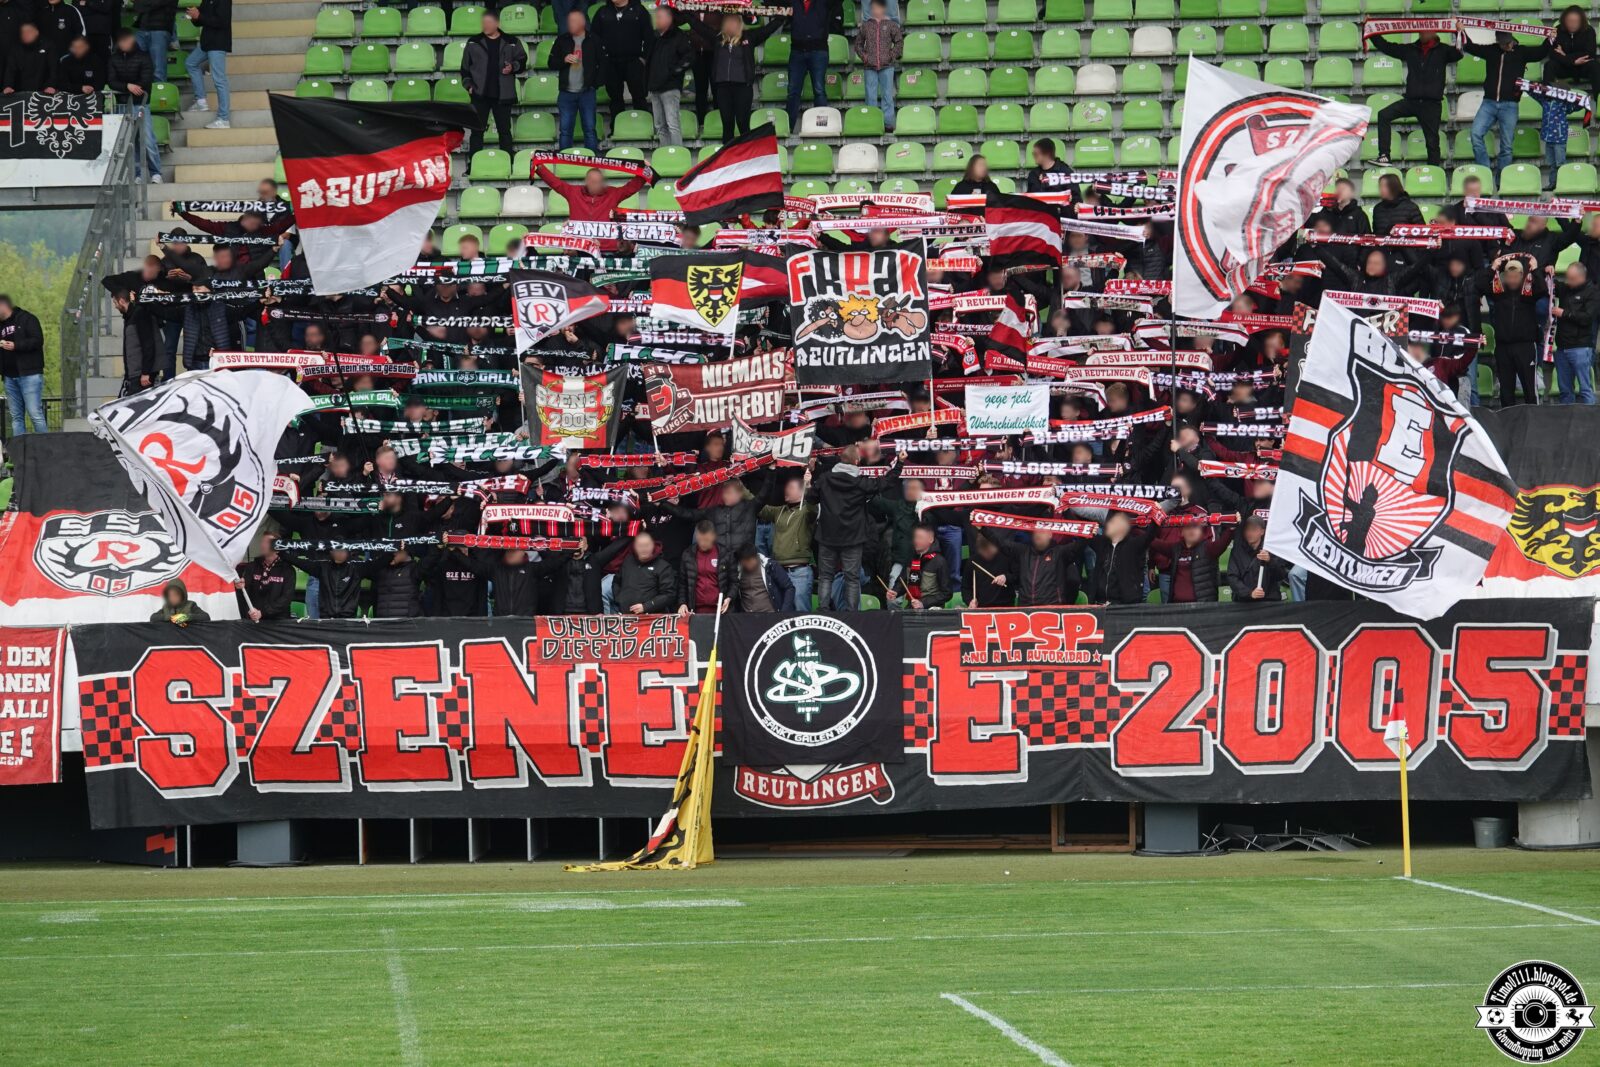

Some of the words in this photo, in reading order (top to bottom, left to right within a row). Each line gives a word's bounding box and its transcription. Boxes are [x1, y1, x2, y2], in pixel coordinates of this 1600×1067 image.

[1376, 22, 1390, 31] SSV
[1392, 21, 1439, 31] REUTLINGEN
[1495, 22, 1545, 35] REUTLINGEN
[535, 152, 554, 161] SSV
[557, 153, 623, 169] REUTLINGEN
[625, 161, 638, 170] 05
[1047, 172, 1107, 186] BLOCK
[1111, 183, 1168, 200] BLOCK
[189, 201, 287, 213] COMPADRES
[819, 196, 838, 205] SSV
[841, 195, 902, 203] REUTLINGEN
[905, 196, 918, 204] 05
[1454, 227, 1503, 237] SZENE
[518, 283, 561, 298] SSV
[641, 333, 701, 344] BLOCK
[225, 355, 242, 363] SSV
[244, 355, 296, 364] REUTLINGEN
[298, 356, 309, 364] 05
[797, 341, 931, 367] REUTLINGEN
[1102, 354, 1121, 363] SSV
[1124, 353, 1185, 362] REUTLINGEN
[1188, 354, 1200, 363] 05
[702, 351, 785, 388] NIEMALS
[1068, 370, 1082, 378] SSV
[1085, 369, 1135, 377] REUTLINGEN
[1138, 370, 1148, 379] 05
[536, 384, 597, 409] SZENE
[551, 413, 597, 431] 2005
[1033, 430, 1096, 444] BLOCK
[895, 439, 956, 451] BLOCK
[900, 467, 952, 476] EUTLINGEN
[1002, 461, 1066, 475] BLOCK
[935, 494, 956, 502] SSV
[959, 491, 1025, 501] REUTLINGEN
[1028, 490, 1041, 498] 05
[486, 508, 498, 518] SV
[501, 508, 559, 518] REUTLINGEN
[1035, 521, 1079, 533] SZENE
[1306, 527, 1409, 587] REUTLINGEN
[92, 578, 129, 592] 05
[650, 614, 682, 635] AI
[763, 621, 792, 645] SAINT
[795, 618, 856, 641] BROTHERS
[961, 612, 1097, 652] TPSP
[542, 636, 685, 660] DIFFIDATI
[7, 647, 51, 667] DEN
[971, 651, 987, 663] NO
[993, 651, 1001, 663] A
[1006, 649, 1021, 661] LA
[1027, 650, 1090, 663] AUTORIDAD
[131, 637, 692, 799] SZENE
[927, 631, 1028, 786] E
[1110, 622, 1557, 777] 2005
[762, 716, 795, 741] SANKT
[794, 731, 833, 743] GALLEN
[21, 725, 35, 758] E
[742, 767, 878, 800] REUTLINGEN
